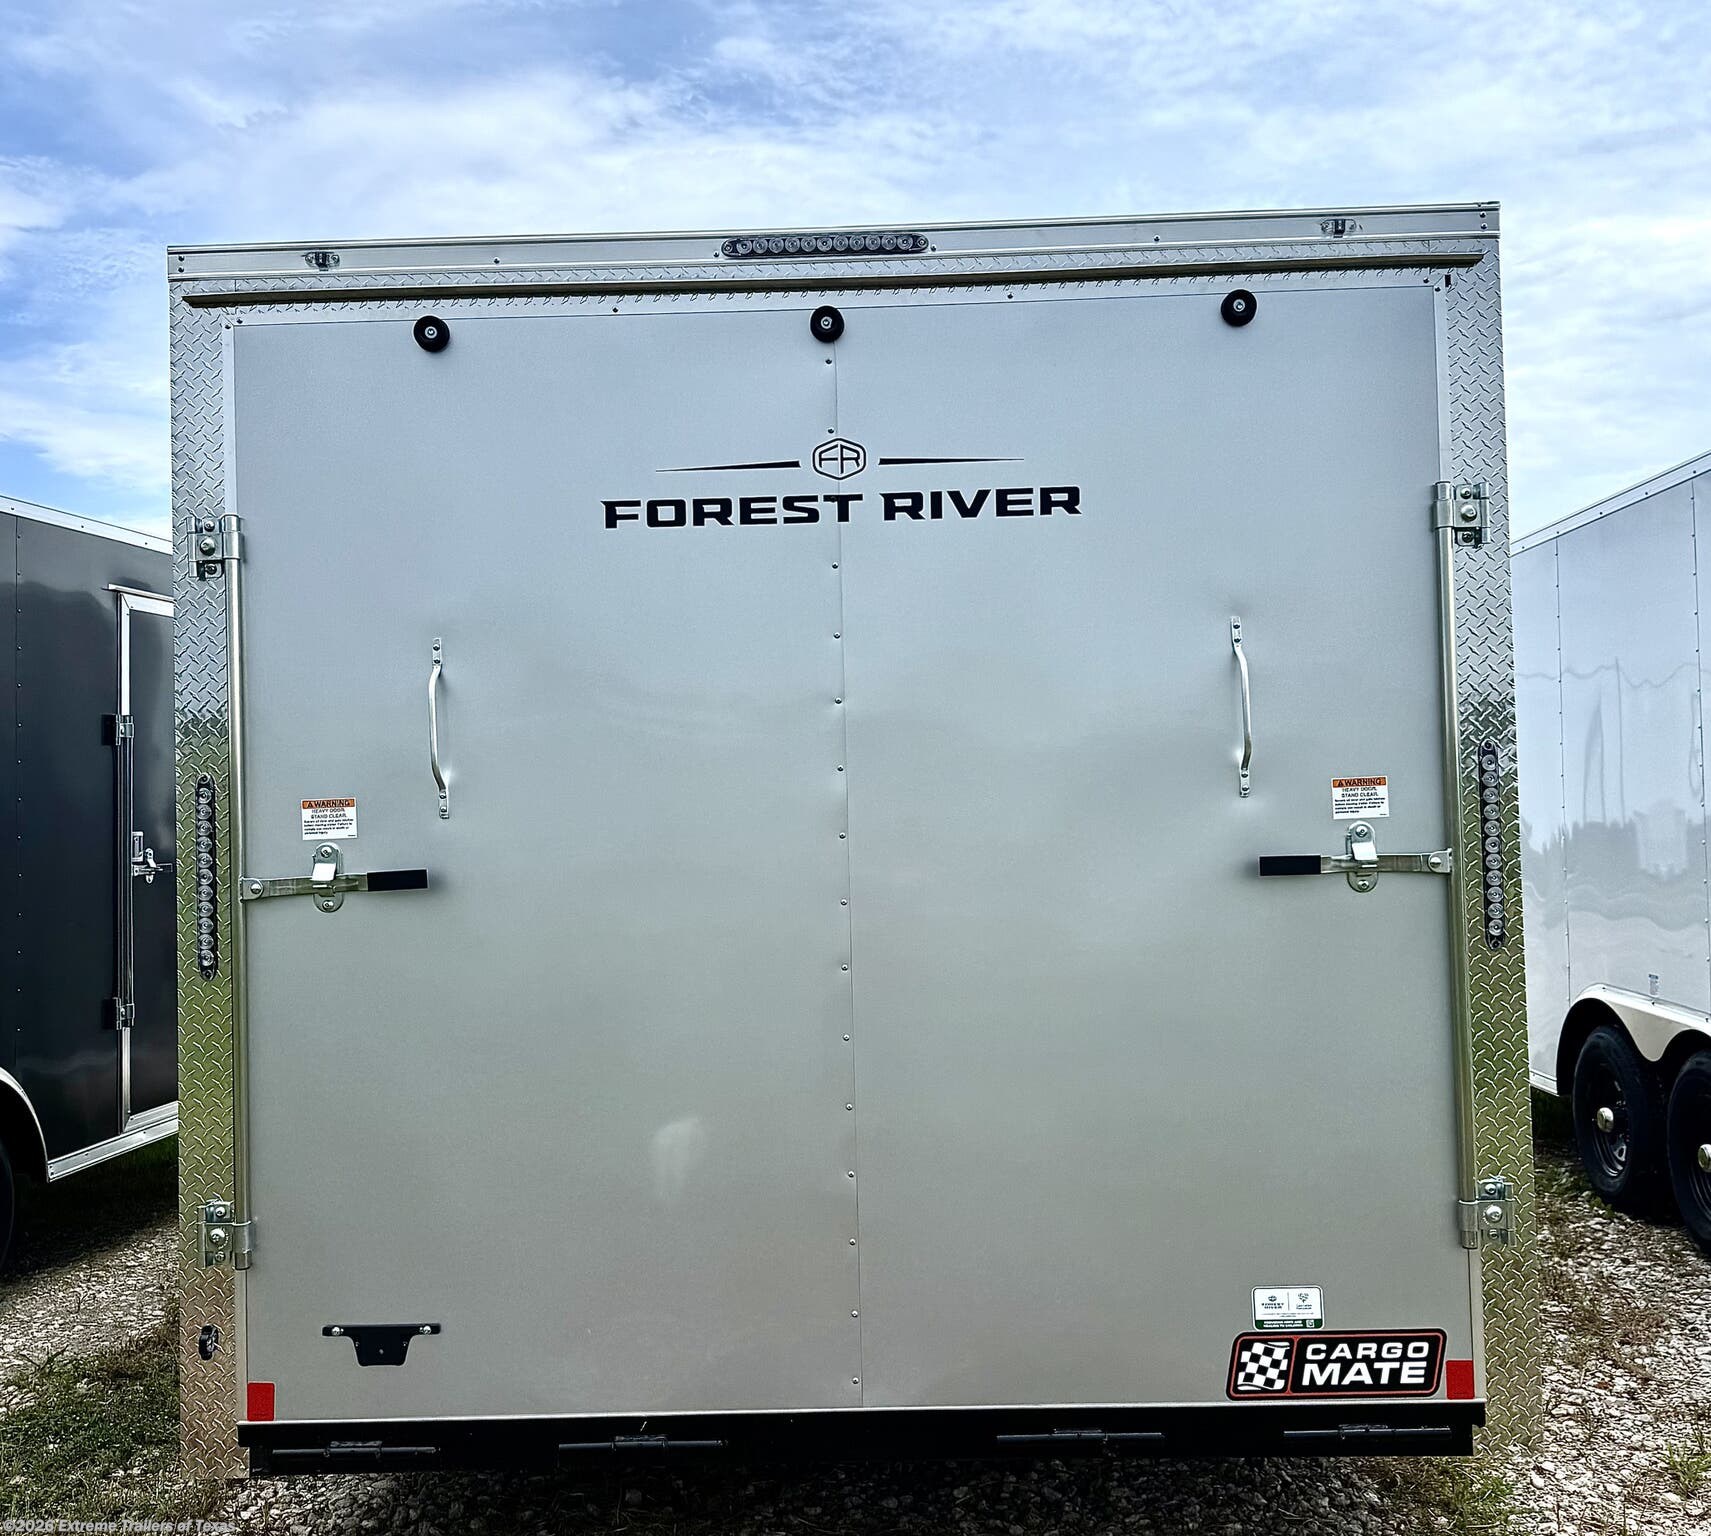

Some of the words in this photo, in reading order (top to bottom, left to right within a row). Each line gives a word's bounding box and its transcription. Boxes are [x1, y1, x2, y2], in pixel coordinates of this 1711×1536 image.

[600, 493, 863, 529] FOREST
[878, 486, 1083, 521] RIVER
[1344, 777, 1381, 787] WARNING
[315, 799, 350, 809] WARNING
[1306, 1341, 1429, 1360] CARGO
[1302, 1361, 1427, 1386] MATE
